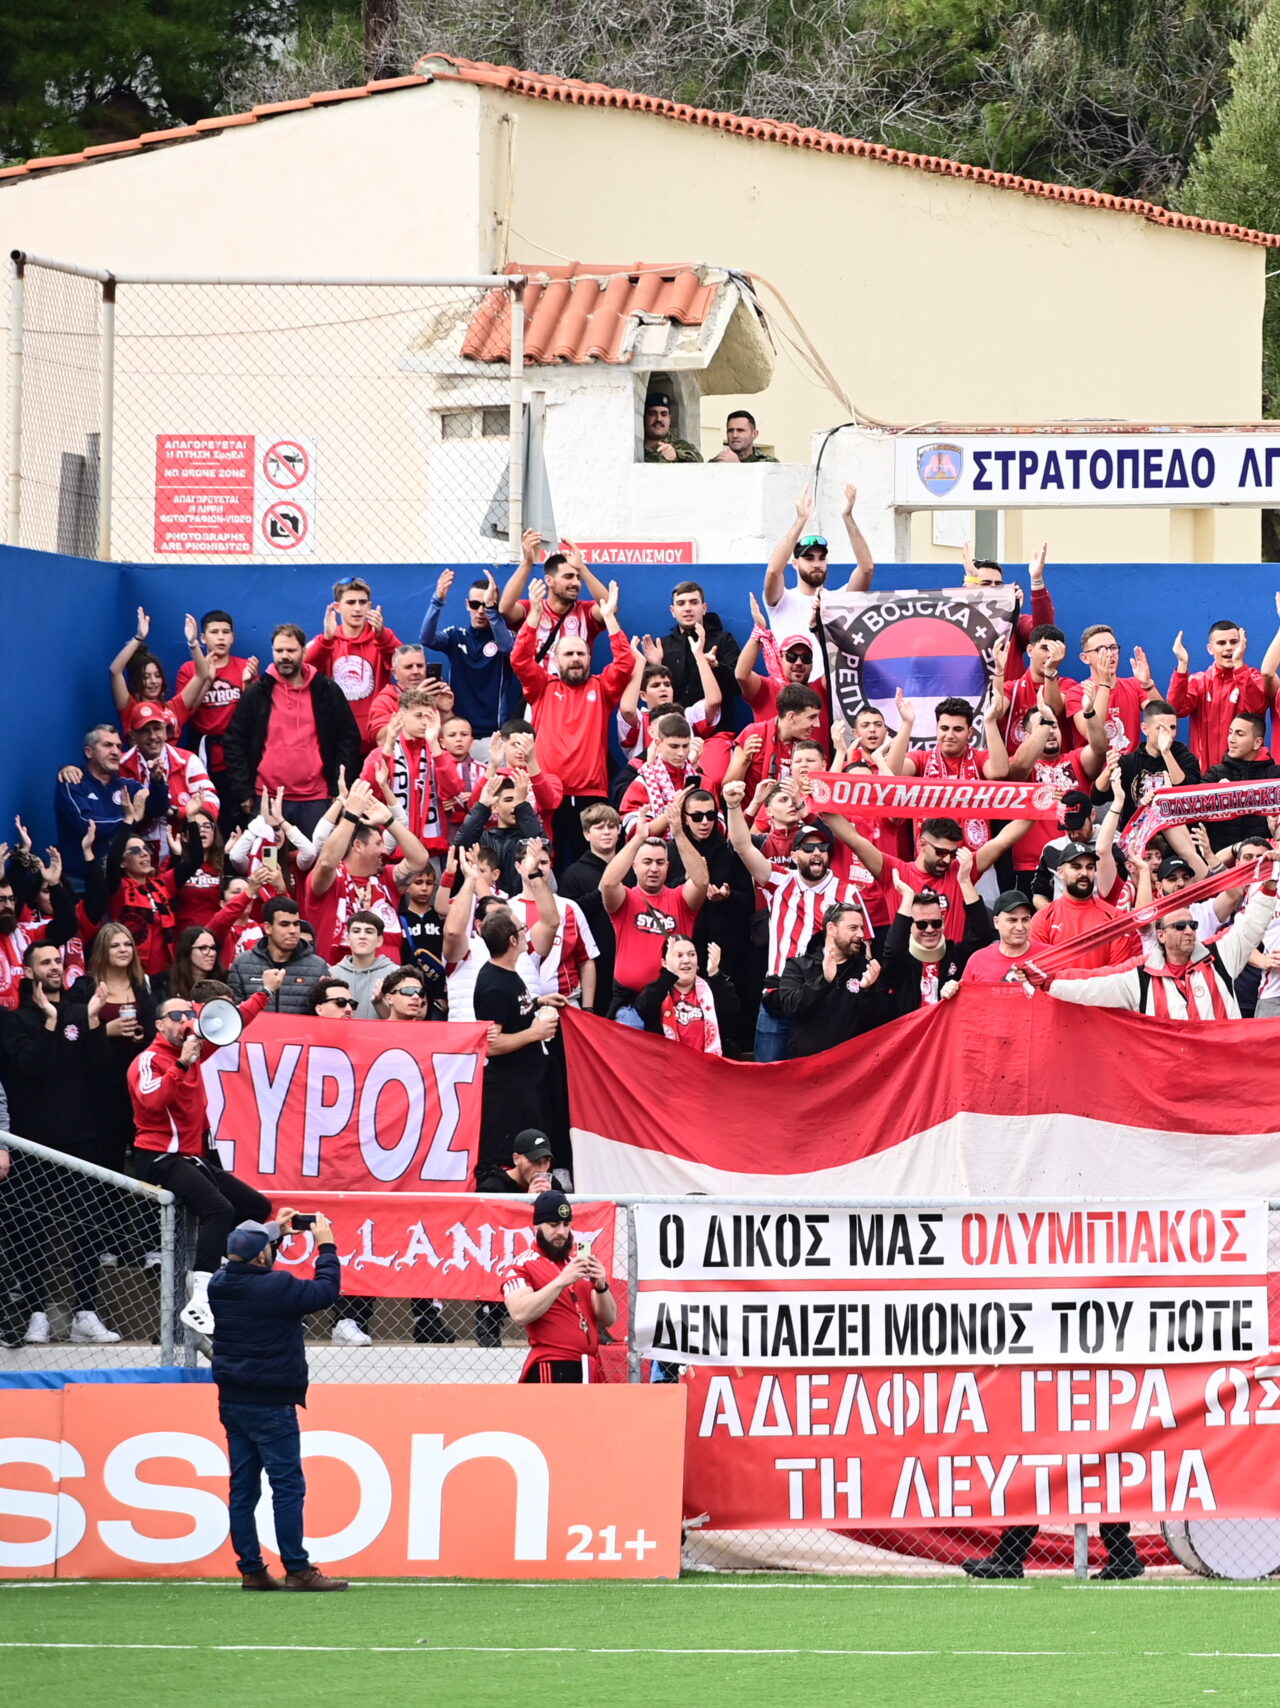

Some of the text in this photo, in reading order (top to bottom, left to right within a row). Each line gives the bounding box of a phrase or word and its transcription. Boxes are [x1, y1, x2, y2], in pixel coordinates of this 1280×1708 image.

[165, 441, 247, 449] ΑΠΑΓΟΡΕΥΕΤΑΙ
[164, 469, 246, 478] NO DRONE ZONE
[973, 448, 1216, 490] ΣΤΡΑΤΟΠΕΔΟ
[161, 543, 250, 551] ARE PROHIBITED
[165, 533, 246, 541] PHOTOGRAPHS
[591, 548, 684, 563] ΚΑΤΑΥΛΙΣΜΟΥ
[658, 1209, 1248, 1269] Ο ΔΙΚΟΣ ΜΑΣ ΟΛΥΜΠΙΑΚΟΣ
[652, 1299, 1254, 1357] ΔΕΝ ΠΑΙΖΕΙ ΜΟΝΟΣ ΤΟΥ ΠΟΤΕ
[699, 1371, 989, 1438] ΑΔΕΛΦΙΑ
[1021, 1368, 1177, 1434] ΓΕΡΑ
[775, 1449, 1217, 1520] ΤΗ ΛΕΥΤΕΡΙΑ
[565, 1525, 658, 1562] 21+
